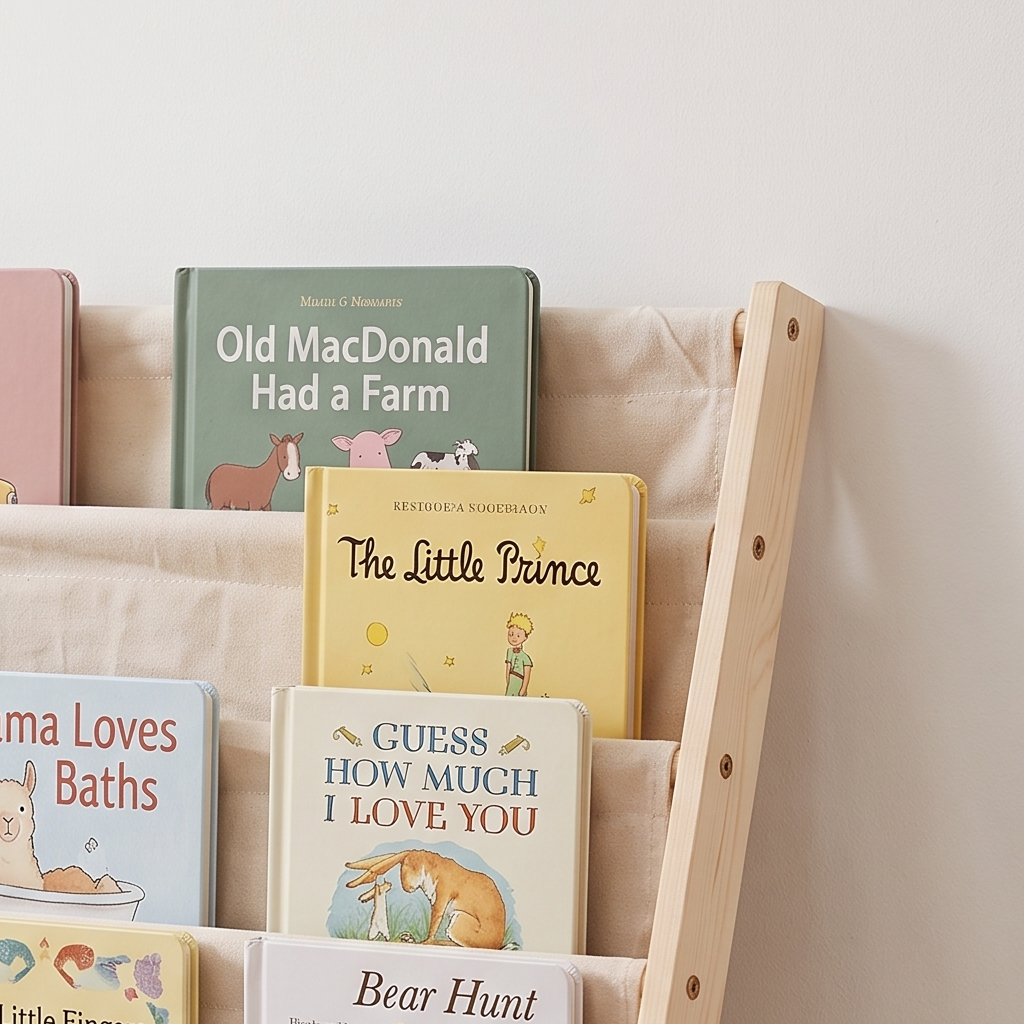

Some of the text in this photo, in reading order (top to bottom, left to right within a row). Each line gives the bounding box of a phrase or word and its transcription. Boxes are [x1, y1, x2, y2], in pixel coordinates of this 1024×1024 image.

[216, 325, 488, 364] Old MacDonald
[252, 373, 449, 411] Had a Farm
[337, 536, 601, 586] The Little Prince
[74, 702, 178, 752] Loves
[373, 723, 488, 756] GUESS
[56, 760, 158, 812] Baths
[325, 758, 538, 797] HOW MUCH
[324, 794, 538, 836] I LOVE YOU
[353, 970, 537, 1021] Bear Hunt
